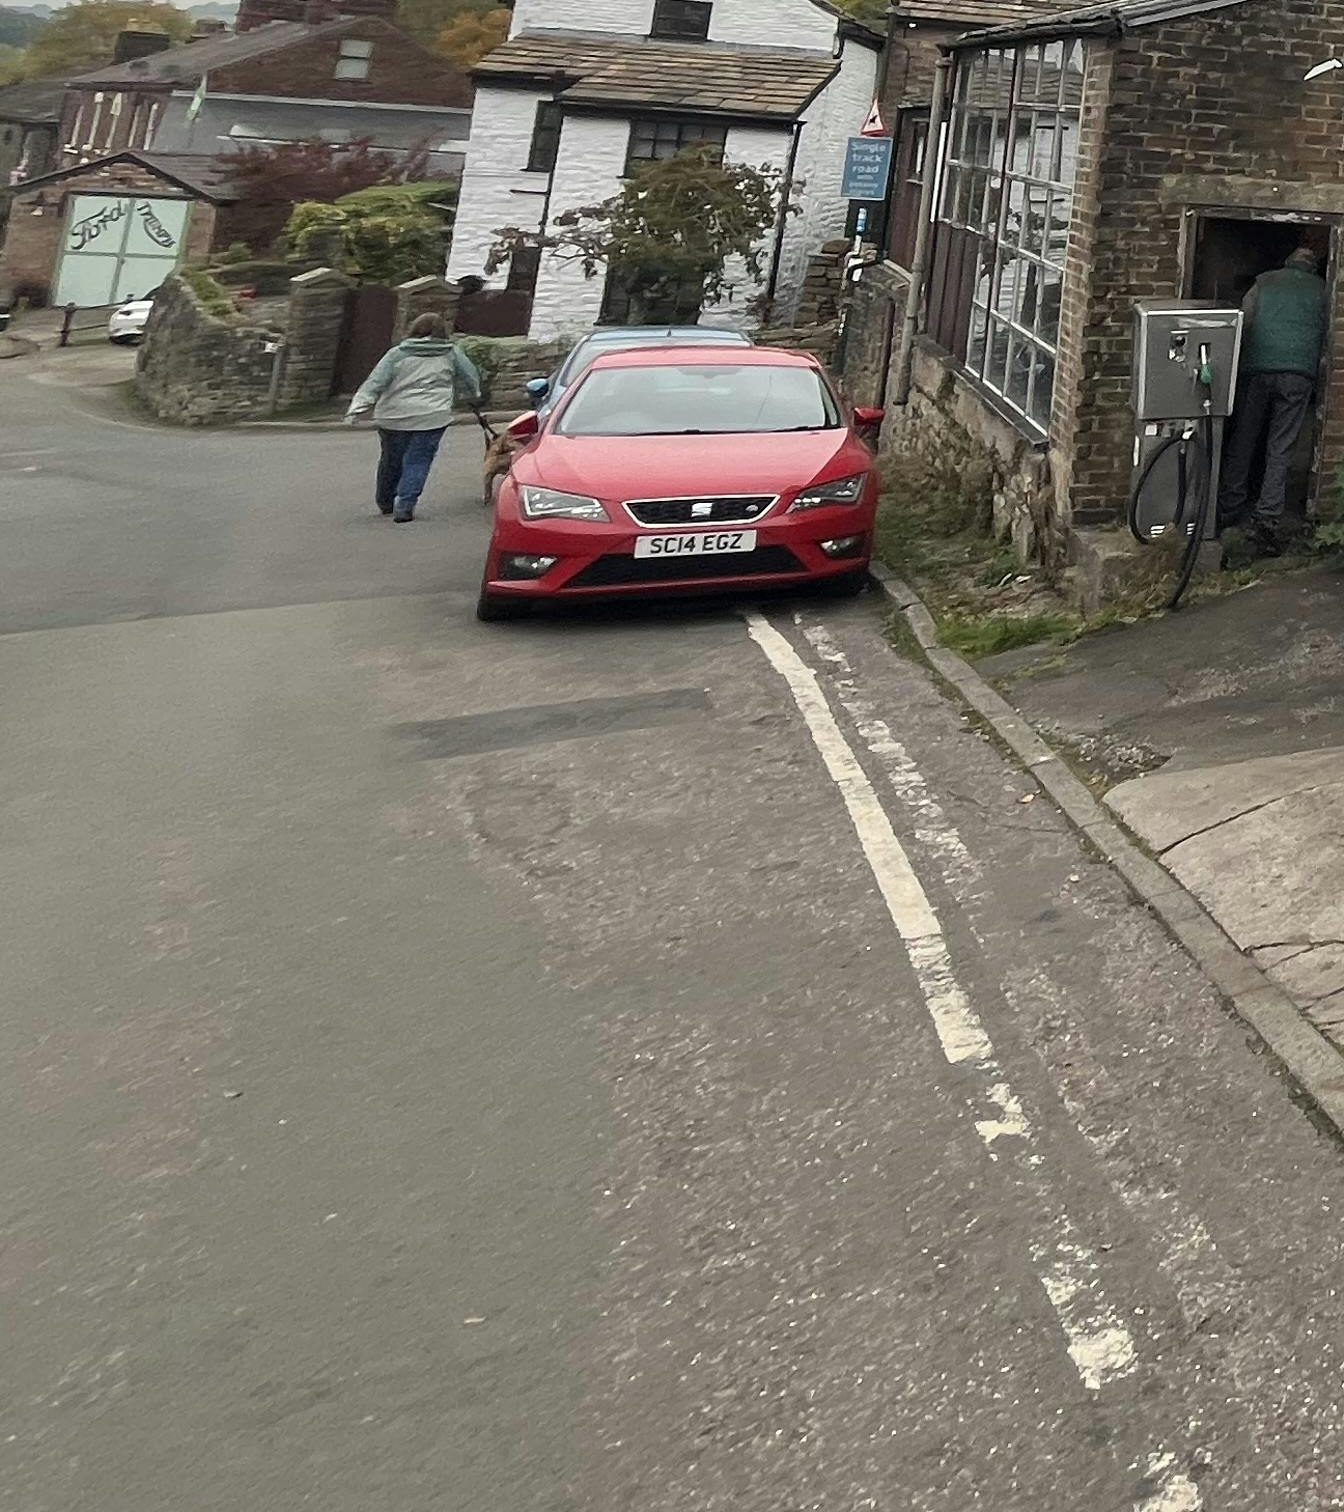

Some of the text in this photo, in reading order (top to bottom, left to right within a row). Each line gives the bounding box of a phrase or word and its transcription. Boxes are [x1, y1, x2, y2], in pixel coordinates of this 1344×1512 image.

[851, 141, 887, 153] Single
[852, 153, 884, 163] track
[851, 165, 880, 174] road
[650, 533, 744, 554] SC14 EGZ
